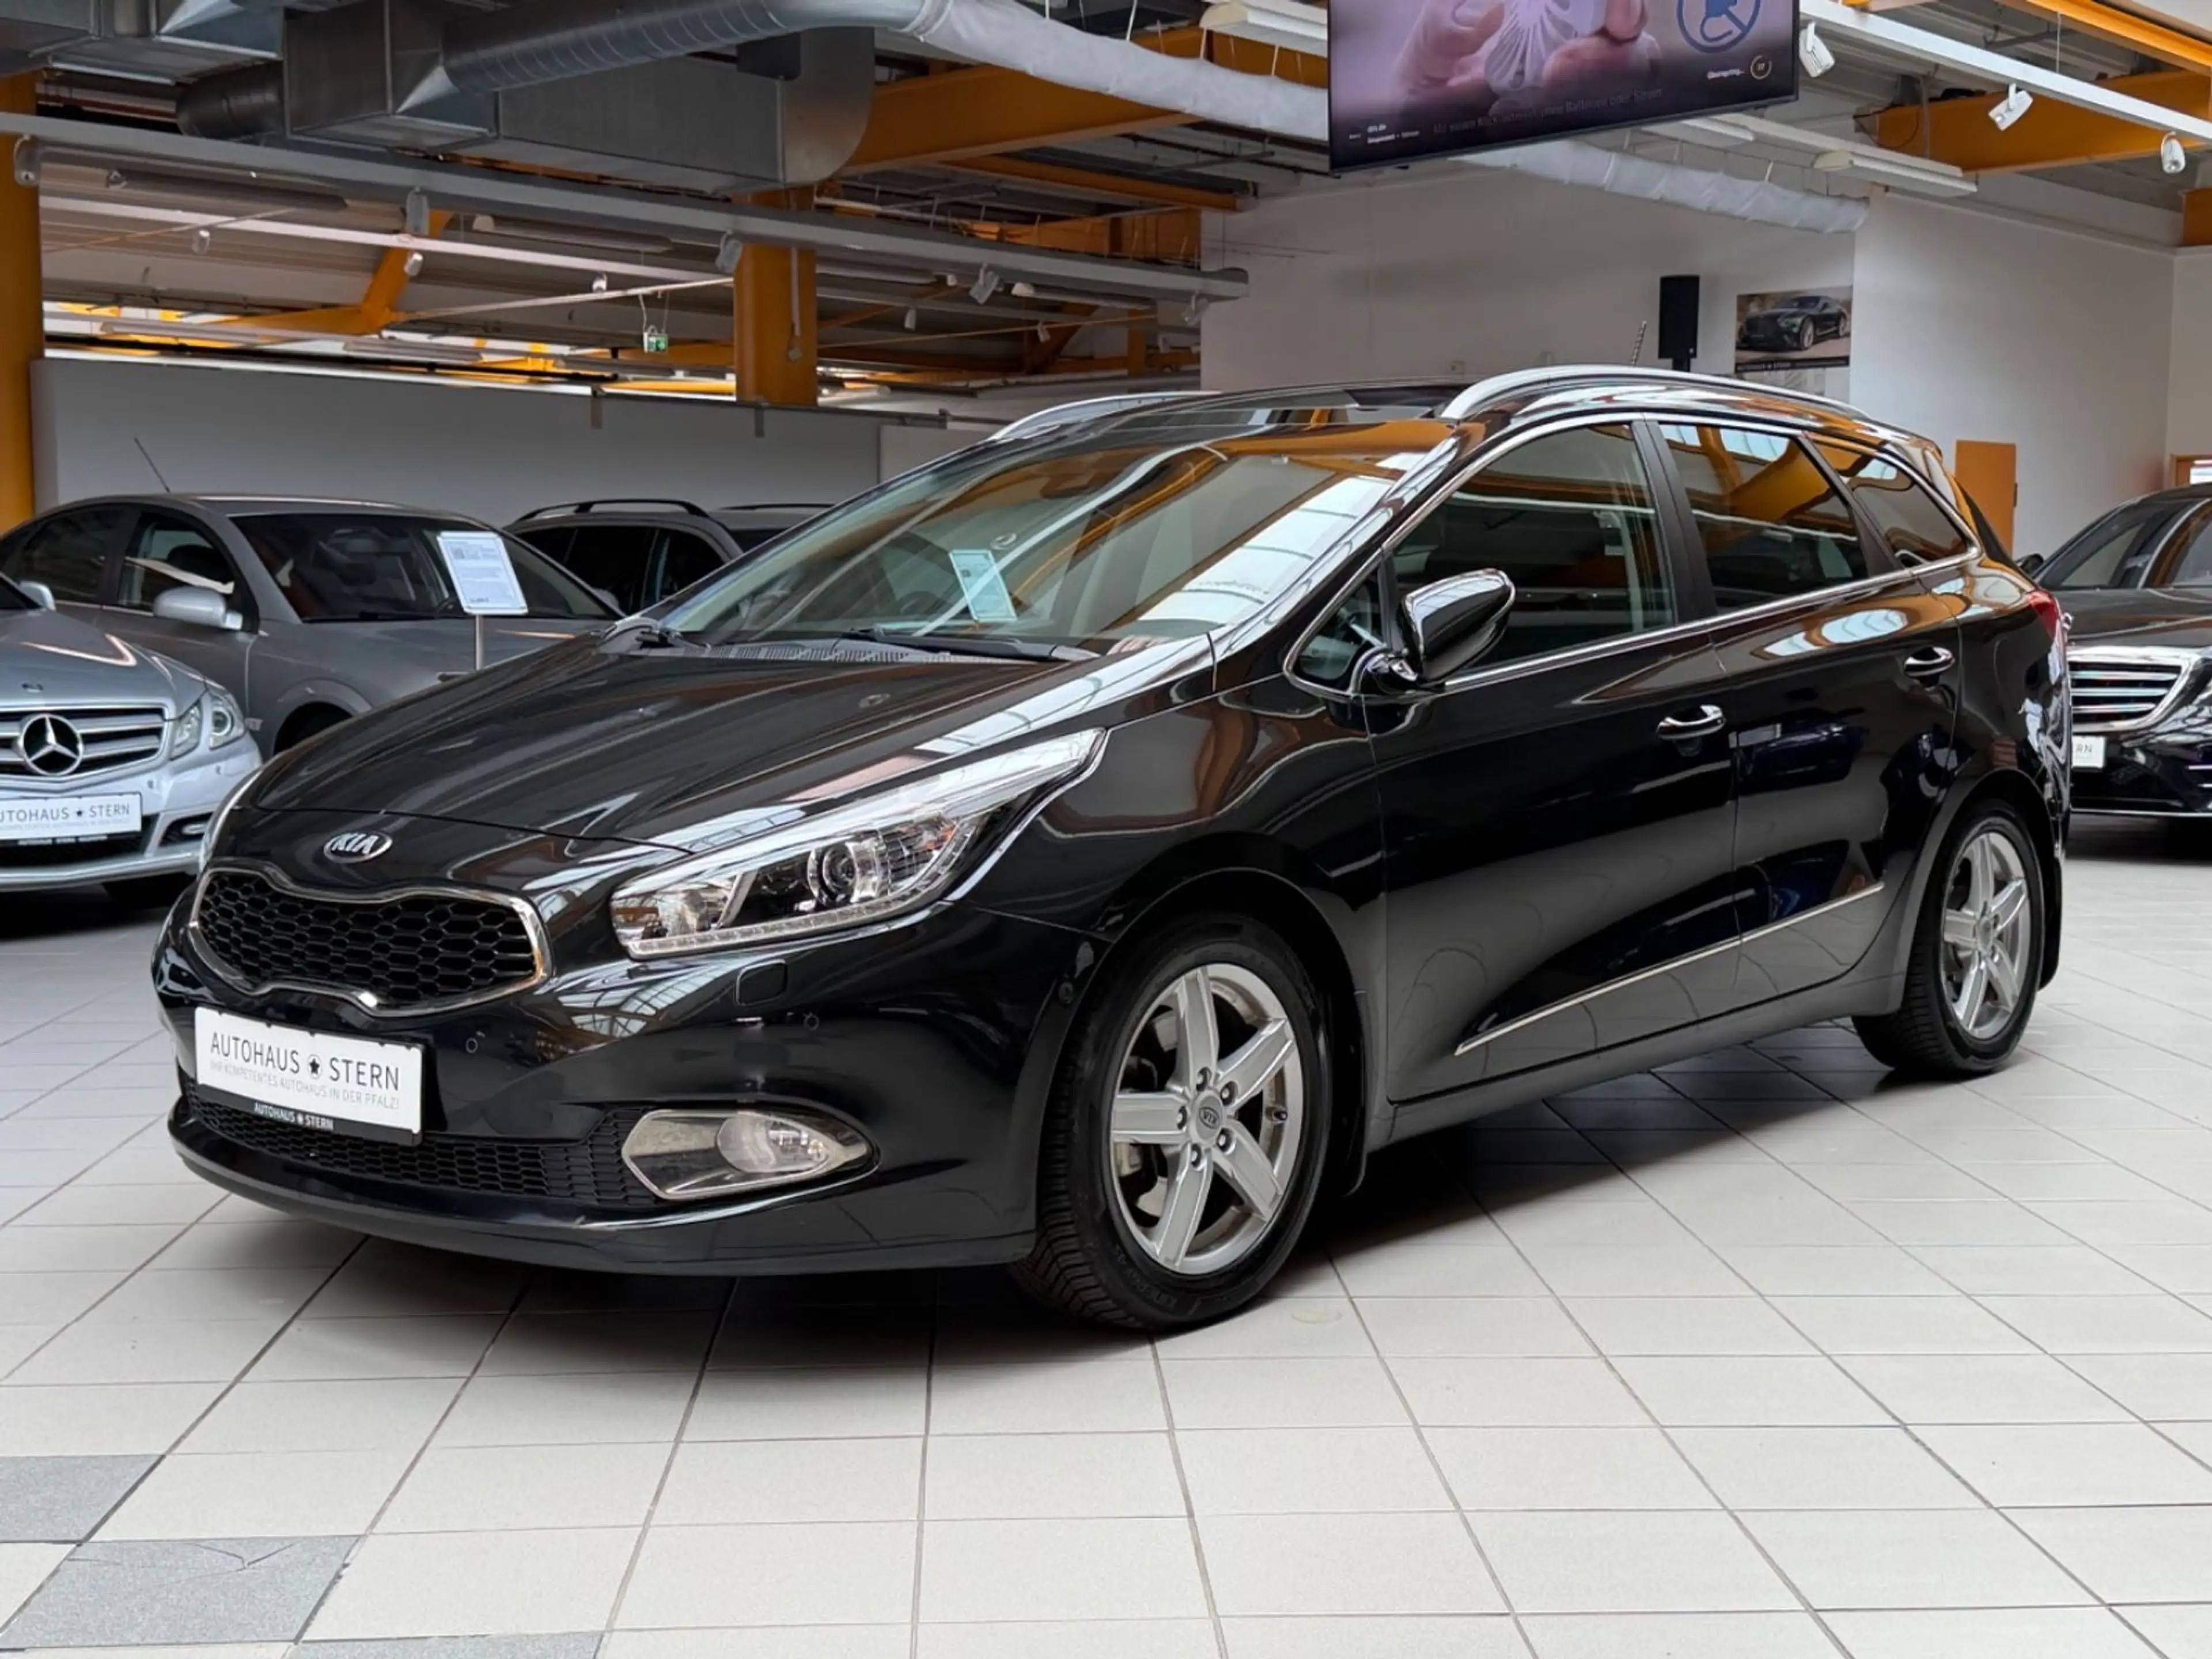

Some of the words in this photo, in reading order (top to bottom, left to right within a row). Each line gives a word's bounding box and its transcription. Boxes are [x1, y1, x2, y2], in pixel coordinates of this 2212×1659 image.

[89, 802, 130, 818] STERN
[331, 832, 380, 854] KIA
[211, 1032, 300, 1074] AUTOHAUS
[329, 1057, 400, 1090] STERN
[279, 1076, 327, 1098] AUTOHAUS
[329, 1087, 339, 1101] IN
[343, 1089, 362, 1104] DER
[365, 1093, 400, 1110] PFALZ!
[254, 1101, 296, 1123] AUTOHAUS
[305, 1114, 334, 1131] STERN
